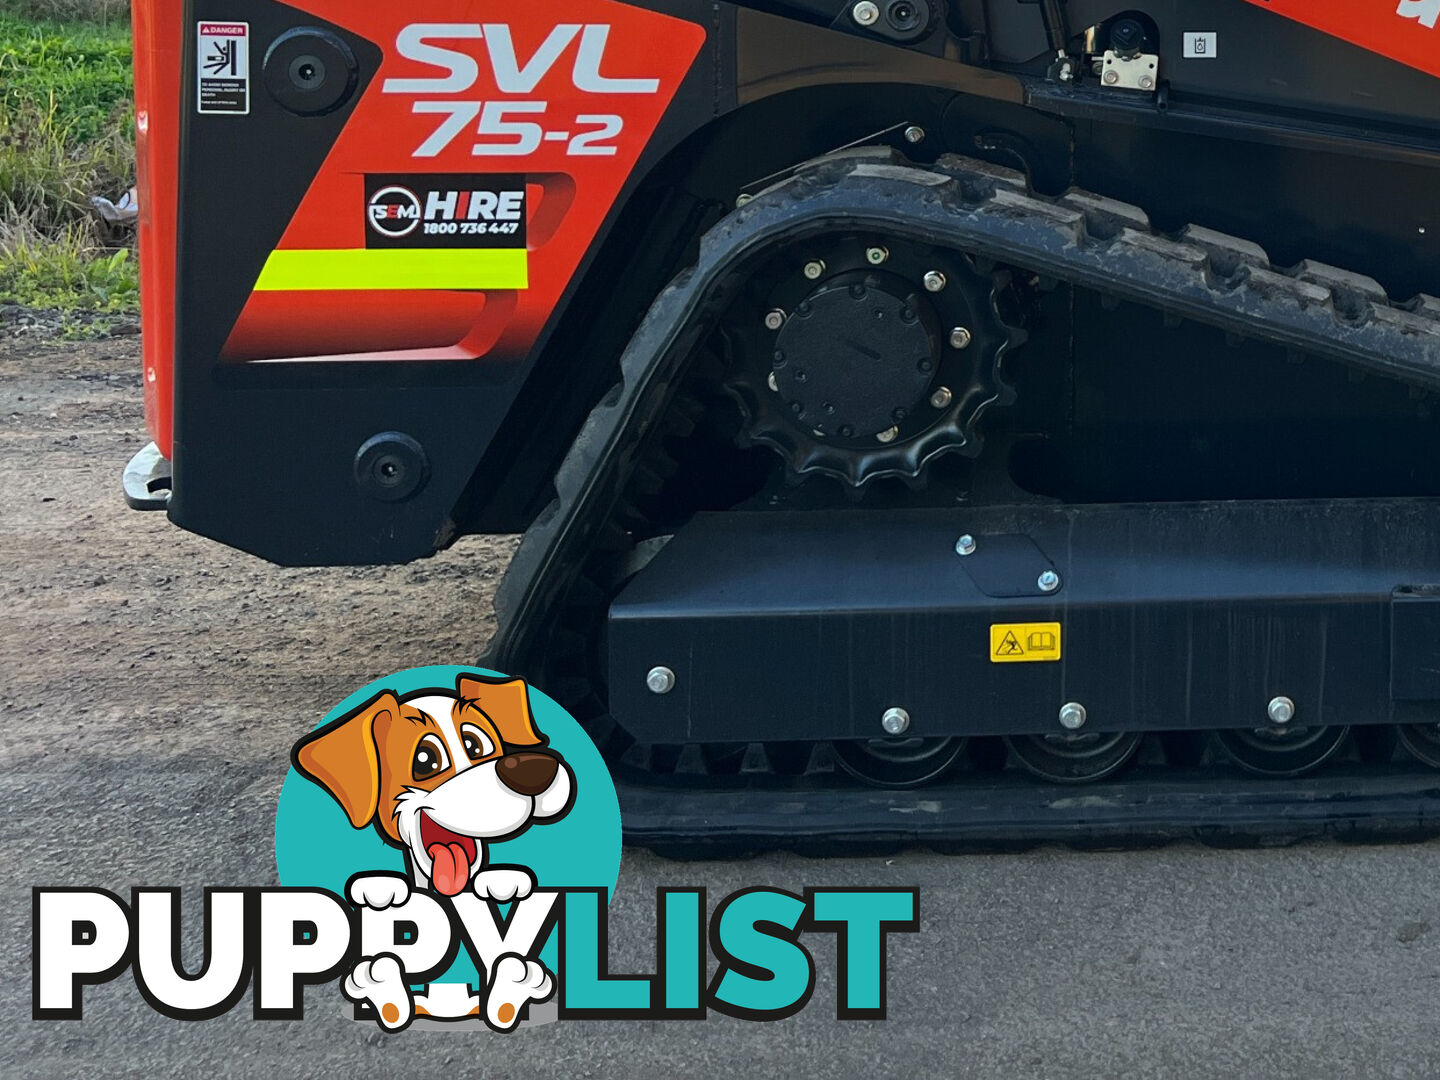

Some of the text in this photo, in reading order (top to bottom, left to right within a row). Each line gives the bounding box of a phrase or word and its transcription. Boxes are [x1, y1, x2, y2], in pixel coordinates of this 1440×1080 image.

[210, 26, 244, 35] DANGER
[382, 24, 661, 94] SVL
[411, 101, 624, 157] 75-2
[424, 191, 525, 220] HIRE
[424, 222, 519, 235] 1800 736 447
